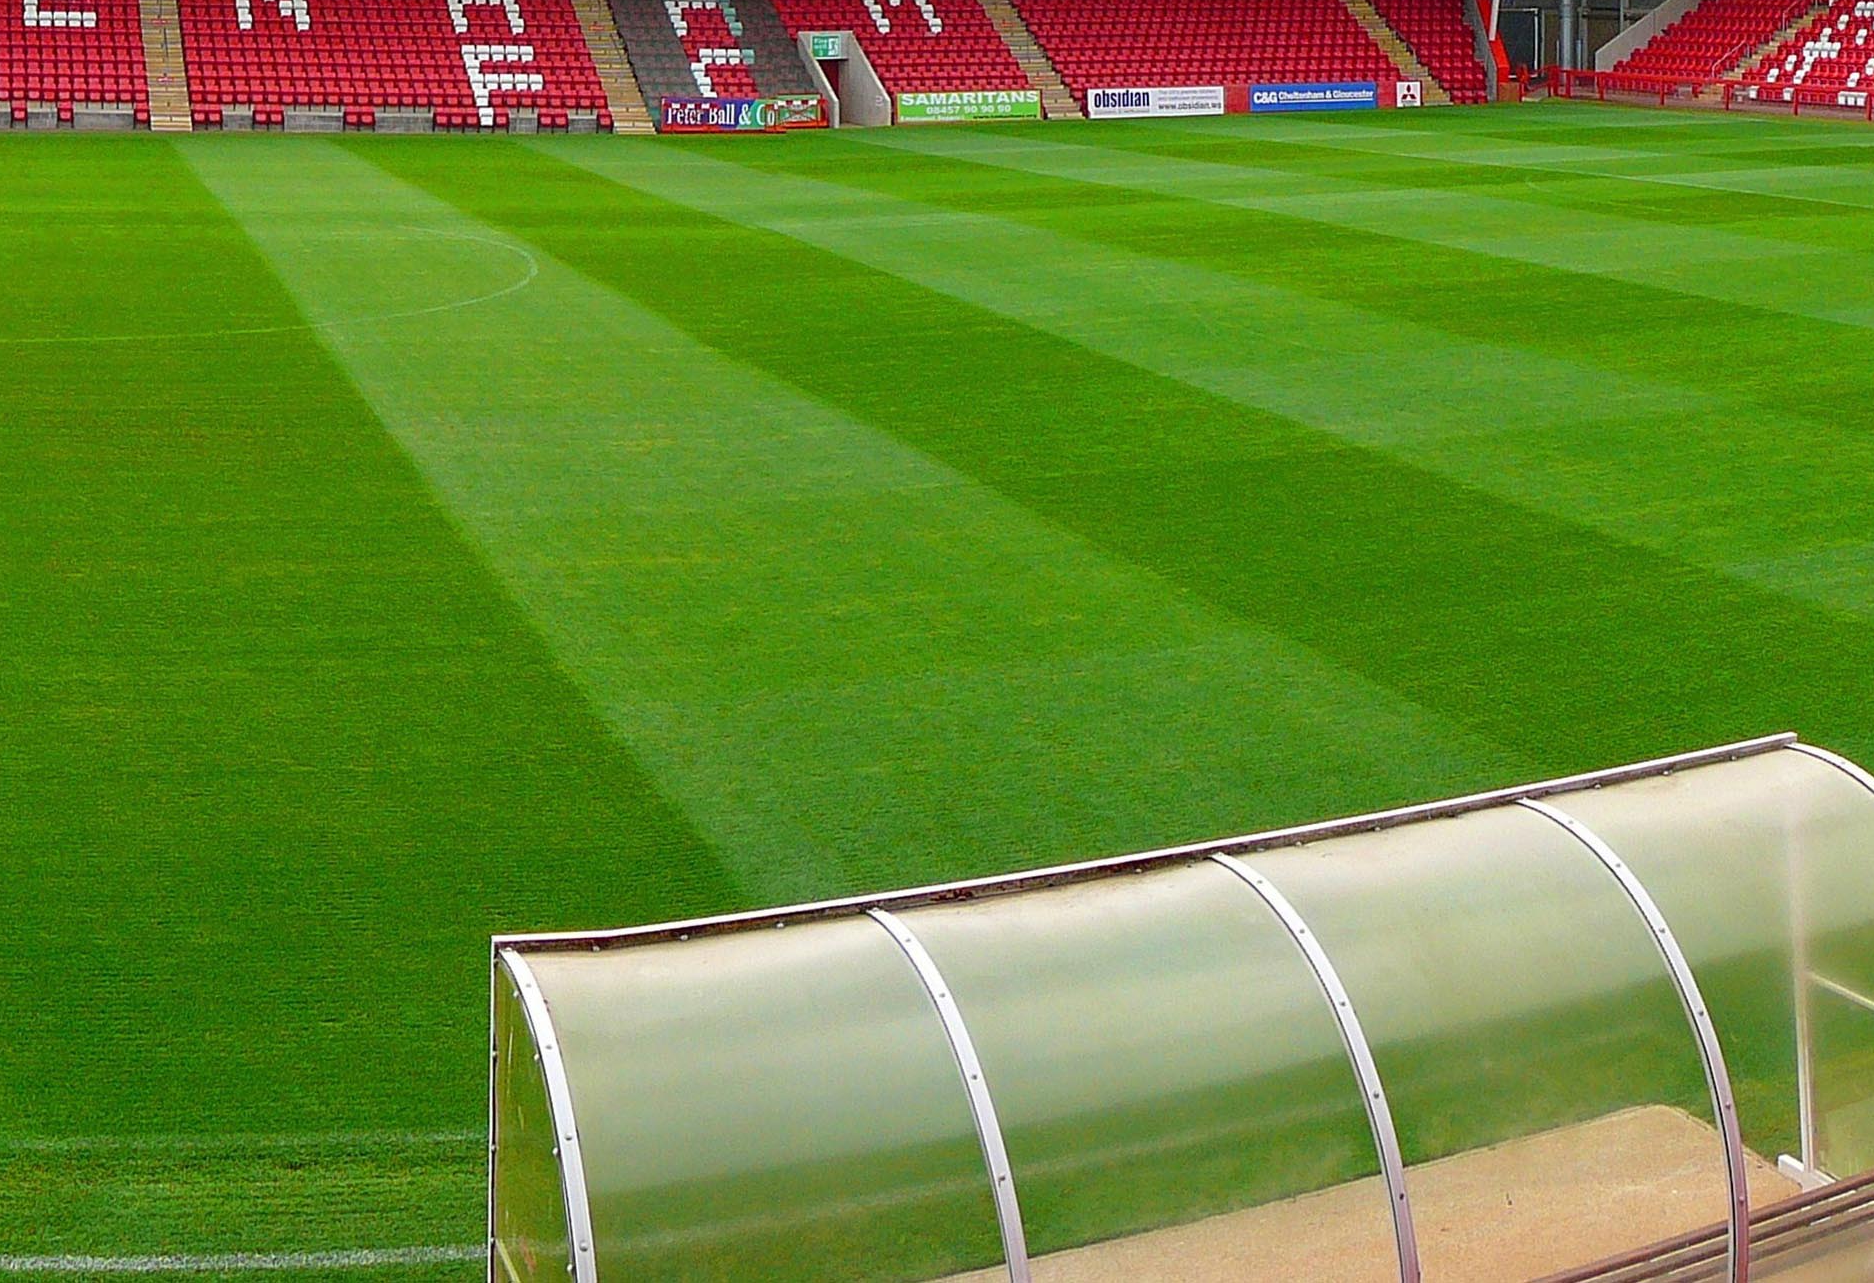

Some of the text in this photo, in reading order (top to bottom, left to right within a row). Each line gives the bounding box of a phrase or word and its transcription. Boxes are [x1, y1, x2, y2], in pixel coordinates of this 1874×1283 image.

[901, 91, 1038, 105] SAMARITANS
[1094, 89, 1150, 108] obsidian
[1254, 90, 1373, 104] C&G Cheltenham & Gloucester
[926, 105, 1011, 114] 08457 90 90 90
[1158, 102, 1221, 110] www.obsidian.ws
[709, 103, 775, 126] Ball & Co
